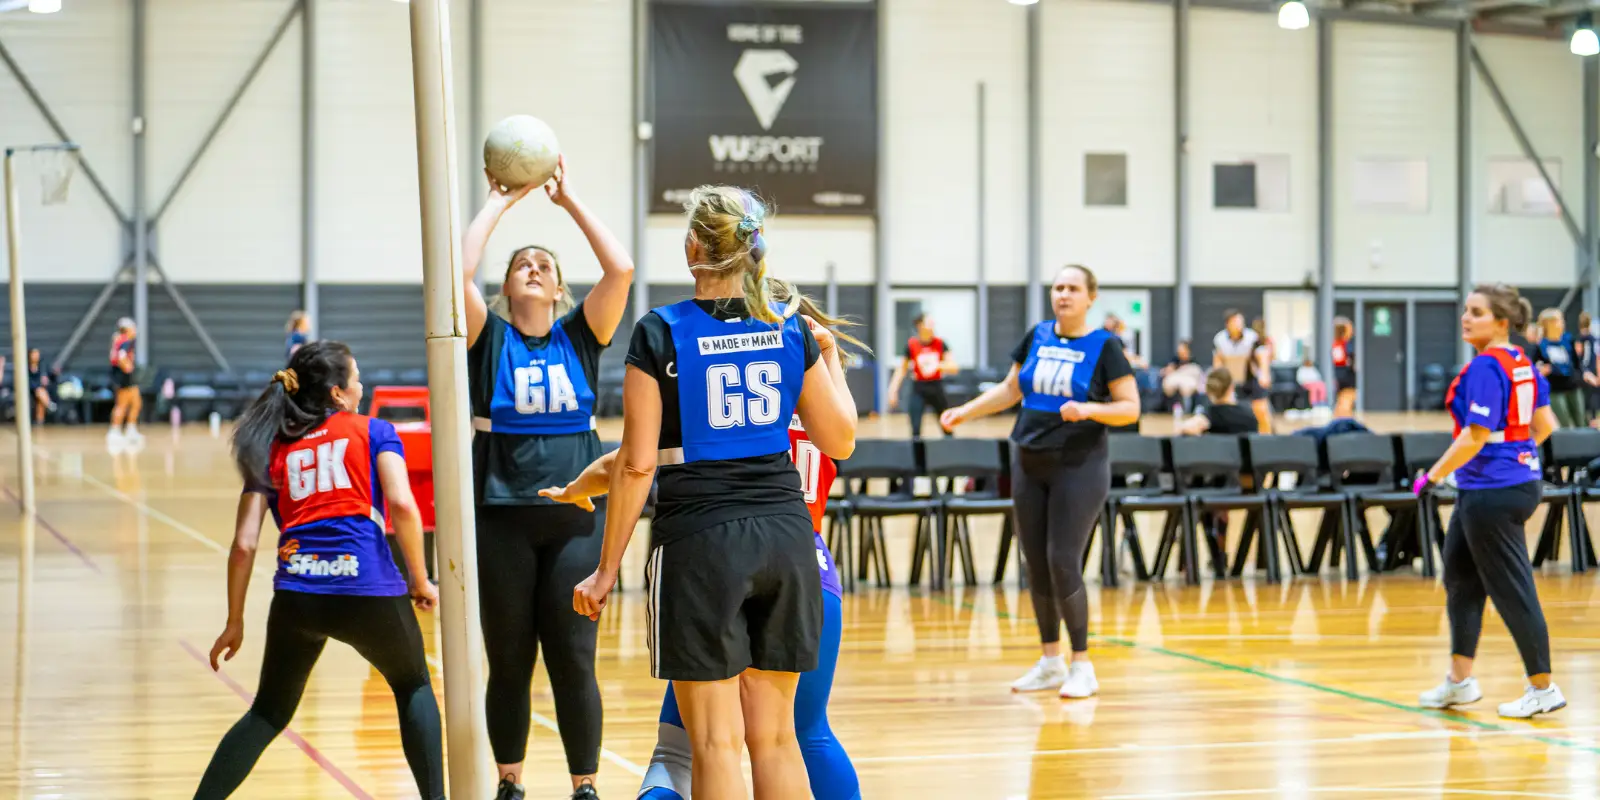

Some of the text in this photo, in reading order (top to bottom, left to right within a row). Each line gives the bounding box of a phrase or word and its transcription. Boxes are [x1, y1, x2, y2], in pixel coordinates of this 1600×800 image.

[709, 135, 823, 162] VUSPORT
[712, 338, 740, 351] MADE
[741, 338, 750, 347] BY
[514, 363, 579, 414] GA
[706, 361, 781, 429] GS
[1032, 359, 1075, 398] WA
[286, 438, 352, 501] GK
[789, 440, 822, 504] D
